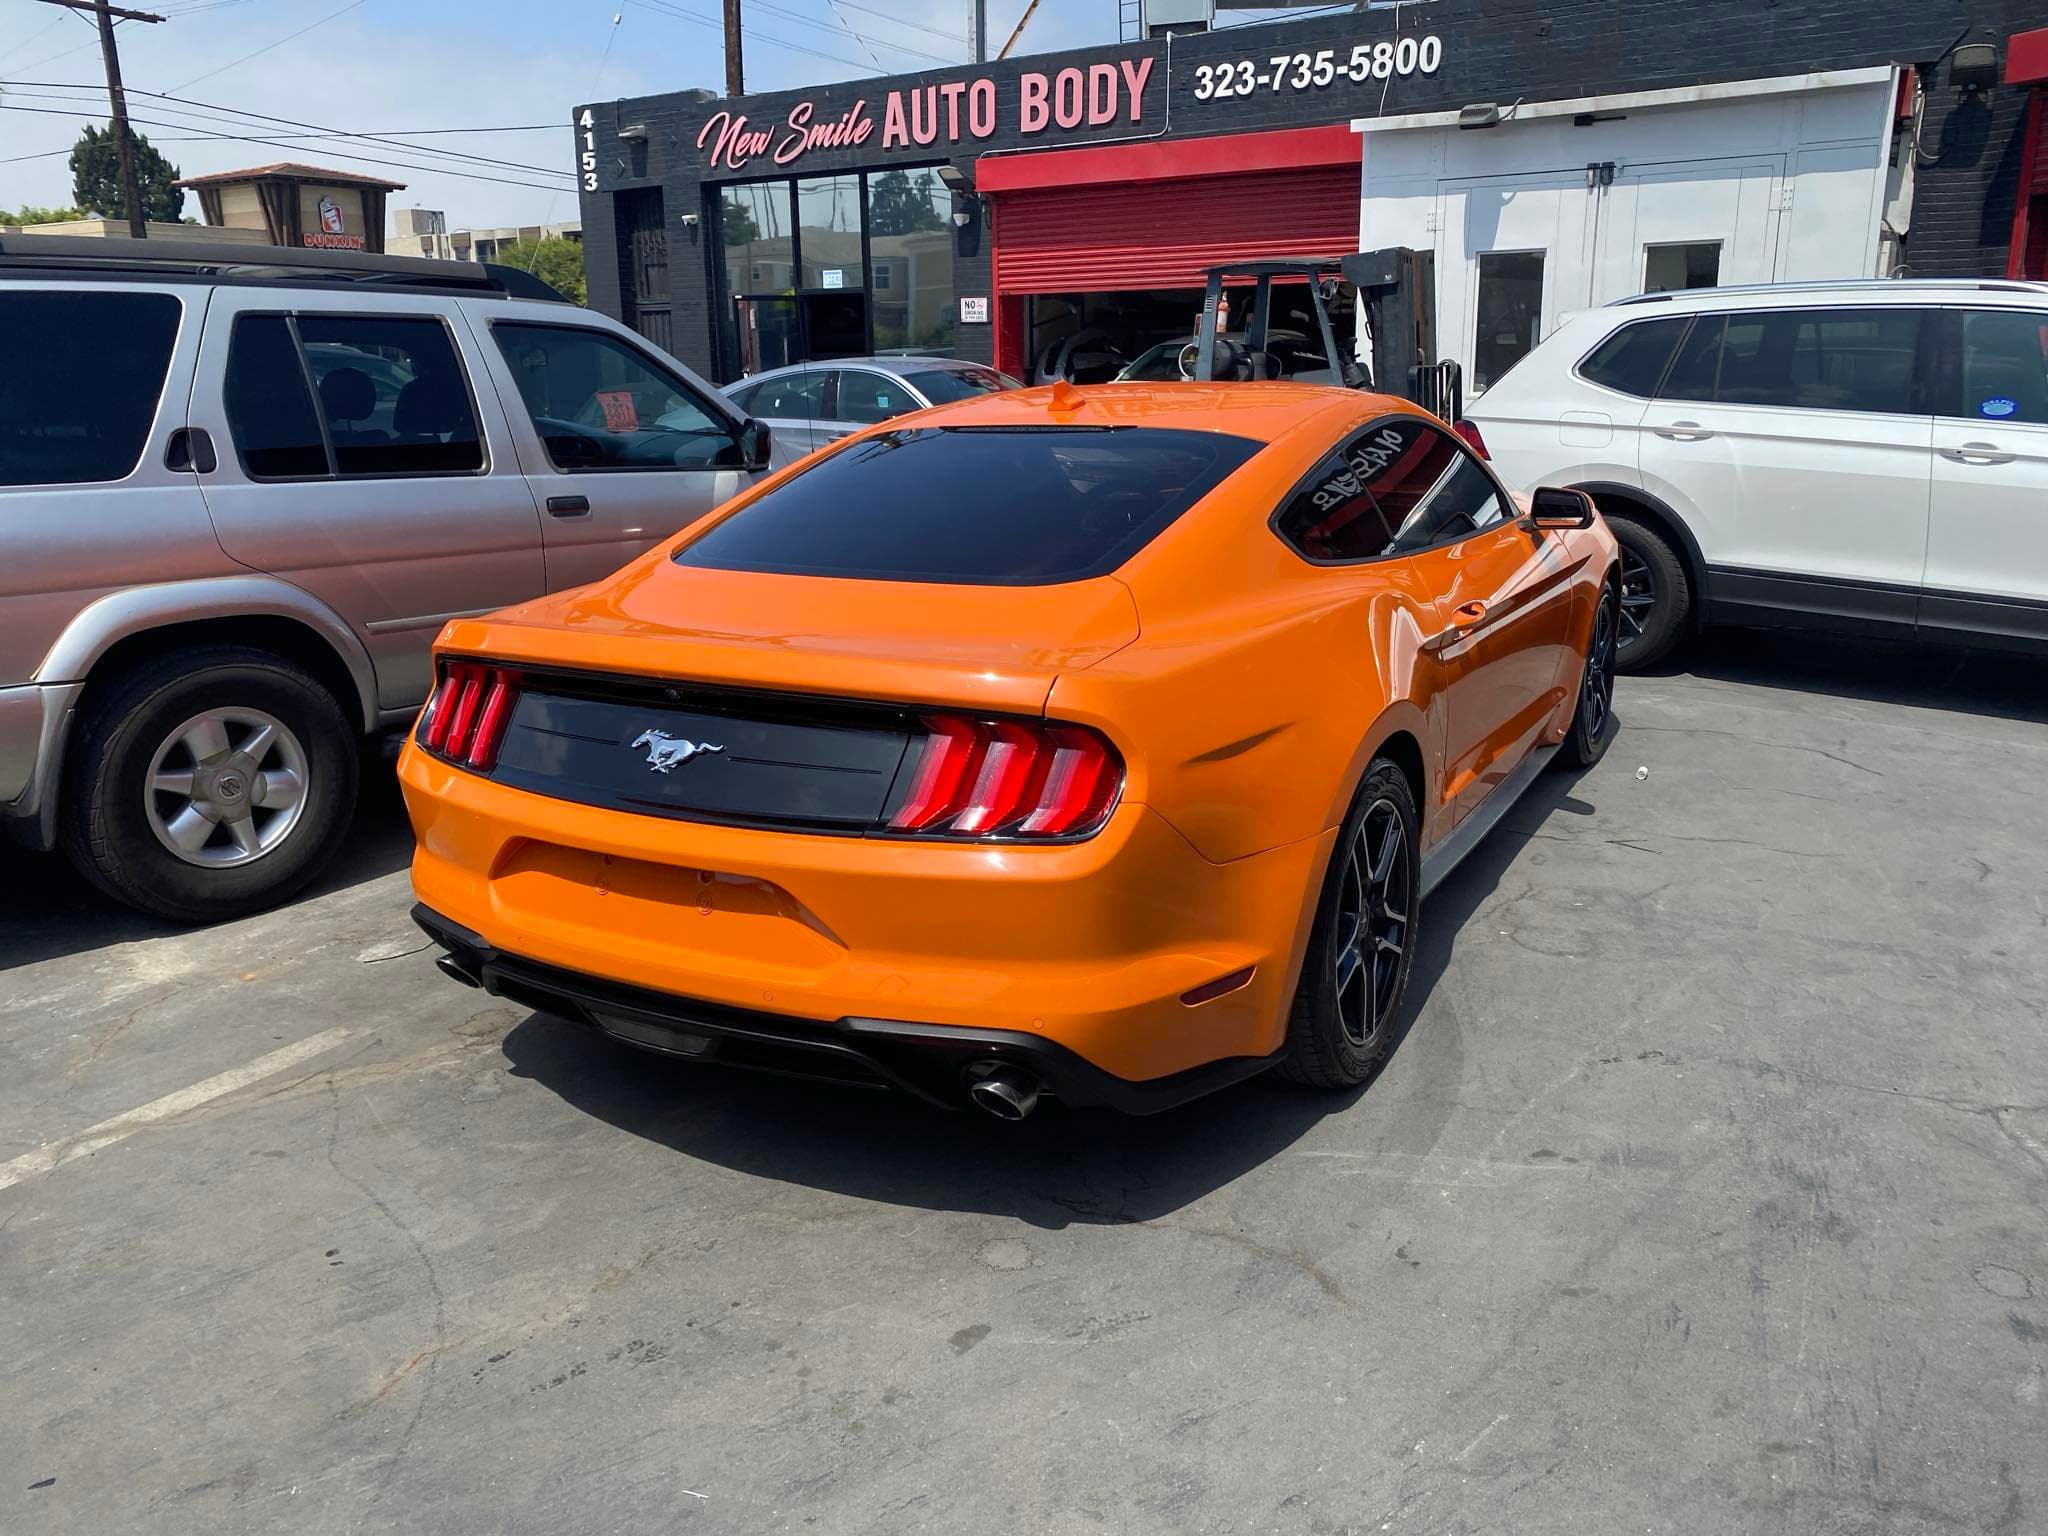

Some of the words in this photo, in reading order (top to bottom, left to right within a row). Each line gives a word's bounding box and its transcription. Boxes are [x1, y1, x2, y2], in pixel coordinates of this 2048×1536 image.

[1193, 35, 1442, 101] 323-735-5800
[579, 109, 598, 191] 4153
[697, 111, 775, 169] New
[774, 100, 874, 164] Smile
[882, 78, 996, 149] AUTO
[1020, 57, 1154, 133] BODY
[964, 300, 976, 309] NO
